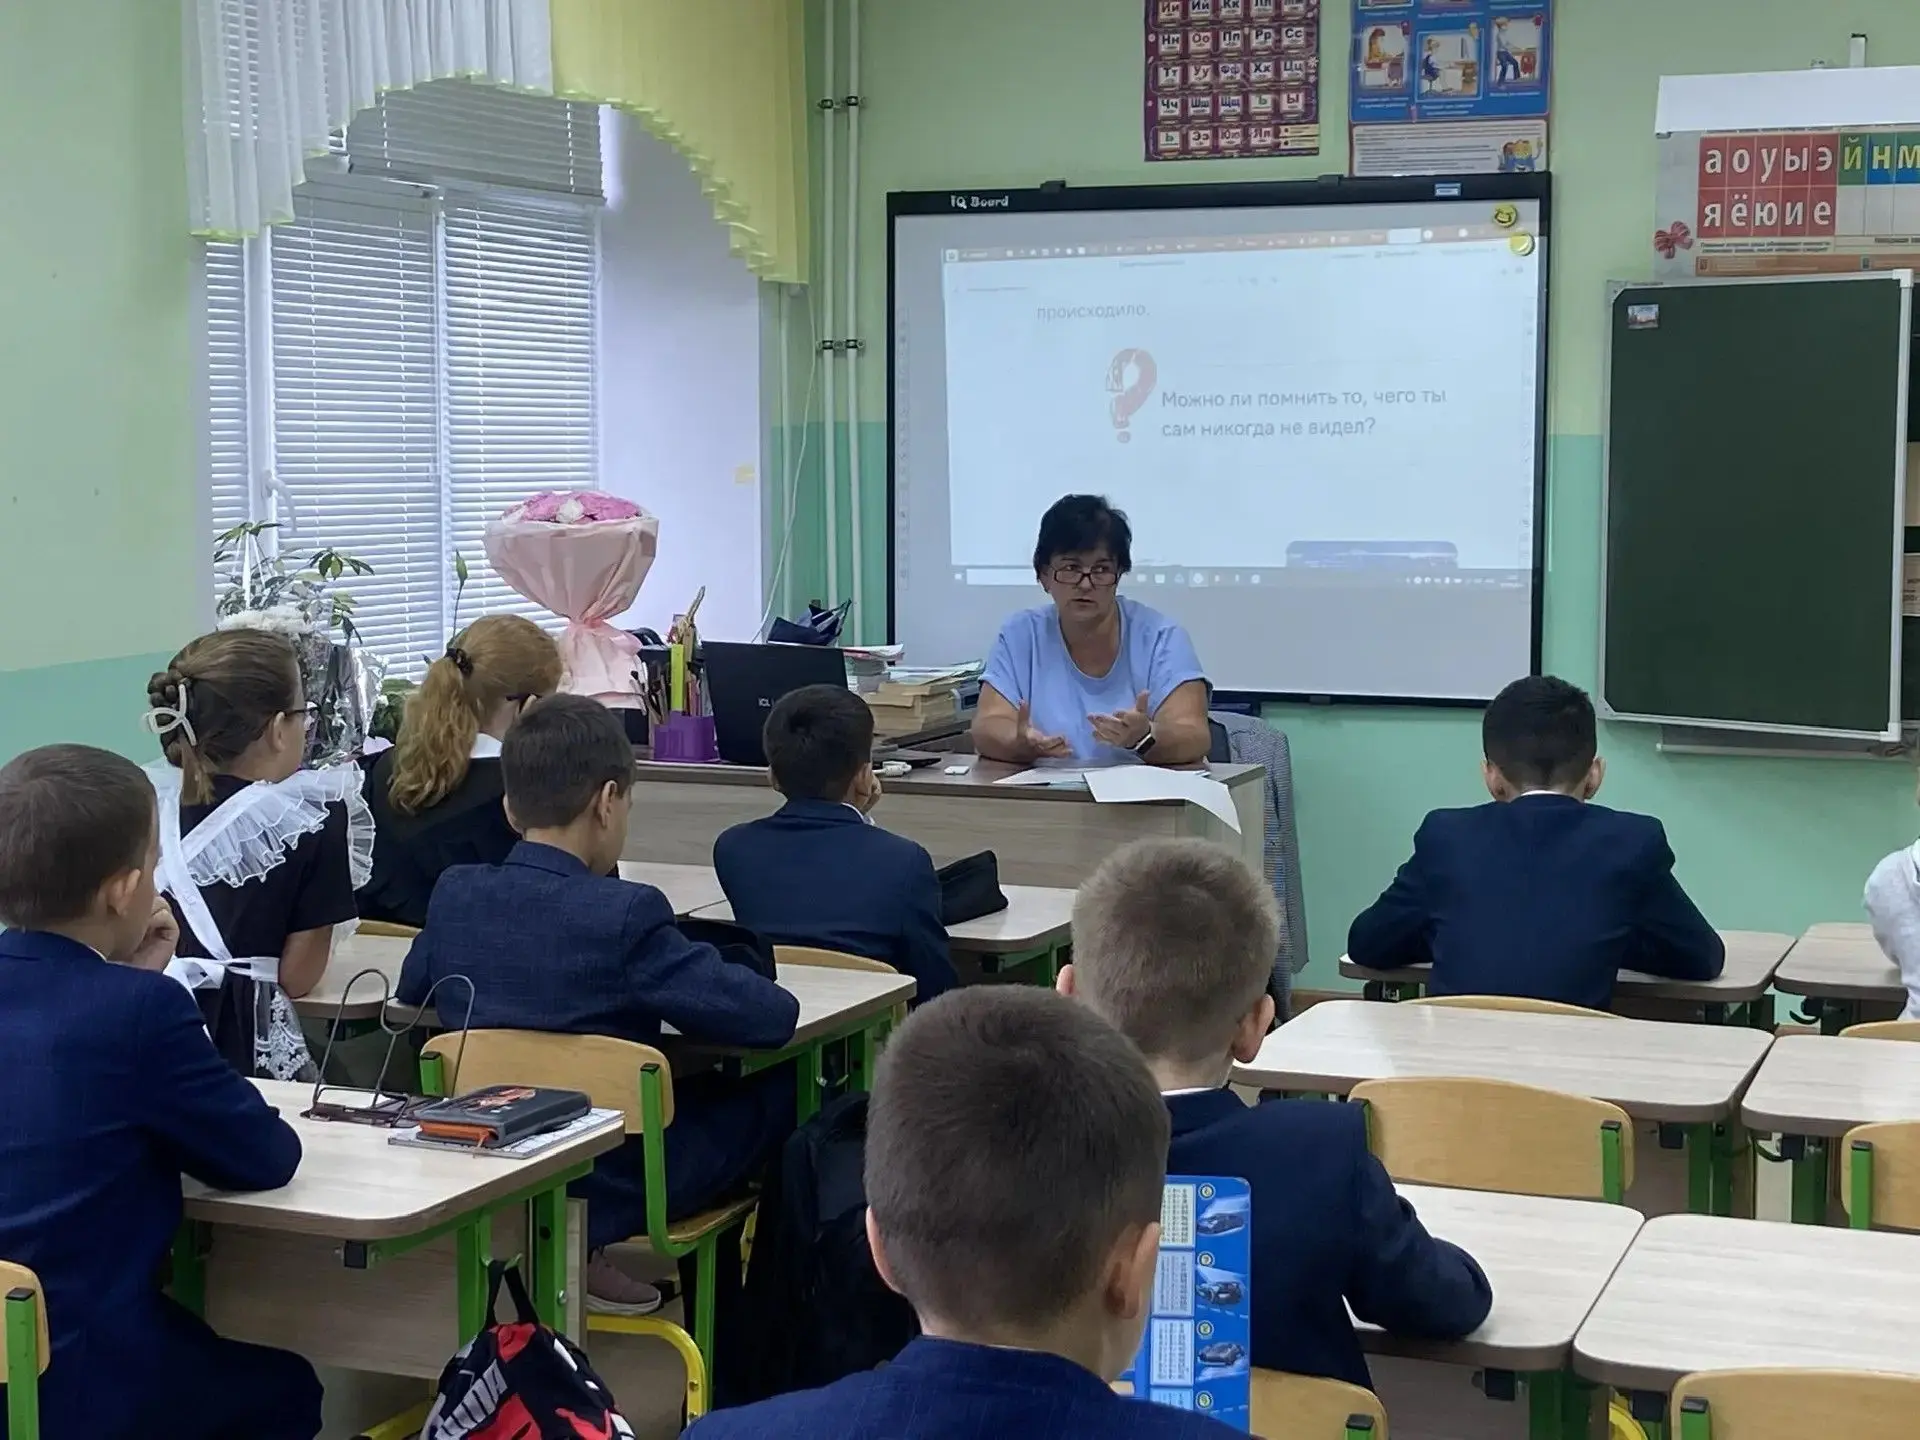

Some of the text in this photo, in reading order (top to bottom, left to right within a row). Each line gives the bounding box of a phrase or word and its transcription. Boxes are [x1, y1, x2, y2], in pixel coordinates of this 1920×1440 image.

[1162, 28, 1303, 45] Нн Оо Пп Рр Сс
[1193, 65, 1210, 78] Уу
[1161, 99, 1178, 109] Чч
[1192, 131, 1209, 141] Ээ
[1705, 150, 1722, 174] а
[1732, 149, 1750, 174] о
[1760, 148, 1778, 183] у
[1785, 147, 1808, 172] ы
[1816, 146, 1832, 172] э
[1843, 136, 1862, 170] й
[1872, 145, 1891, 170] н
[970, 195, 1009, 208] Board
[1703, 194, 1832, 227] я ё ю и е
[1037, 304, 1150, 323] происходило.
[1162, 389, 1447, 408] Можно ли помнить то, чего ты
[1162, 417, 1376, 438] сам никогда не видел?
[434, 1358, 508, 1440] UMA
